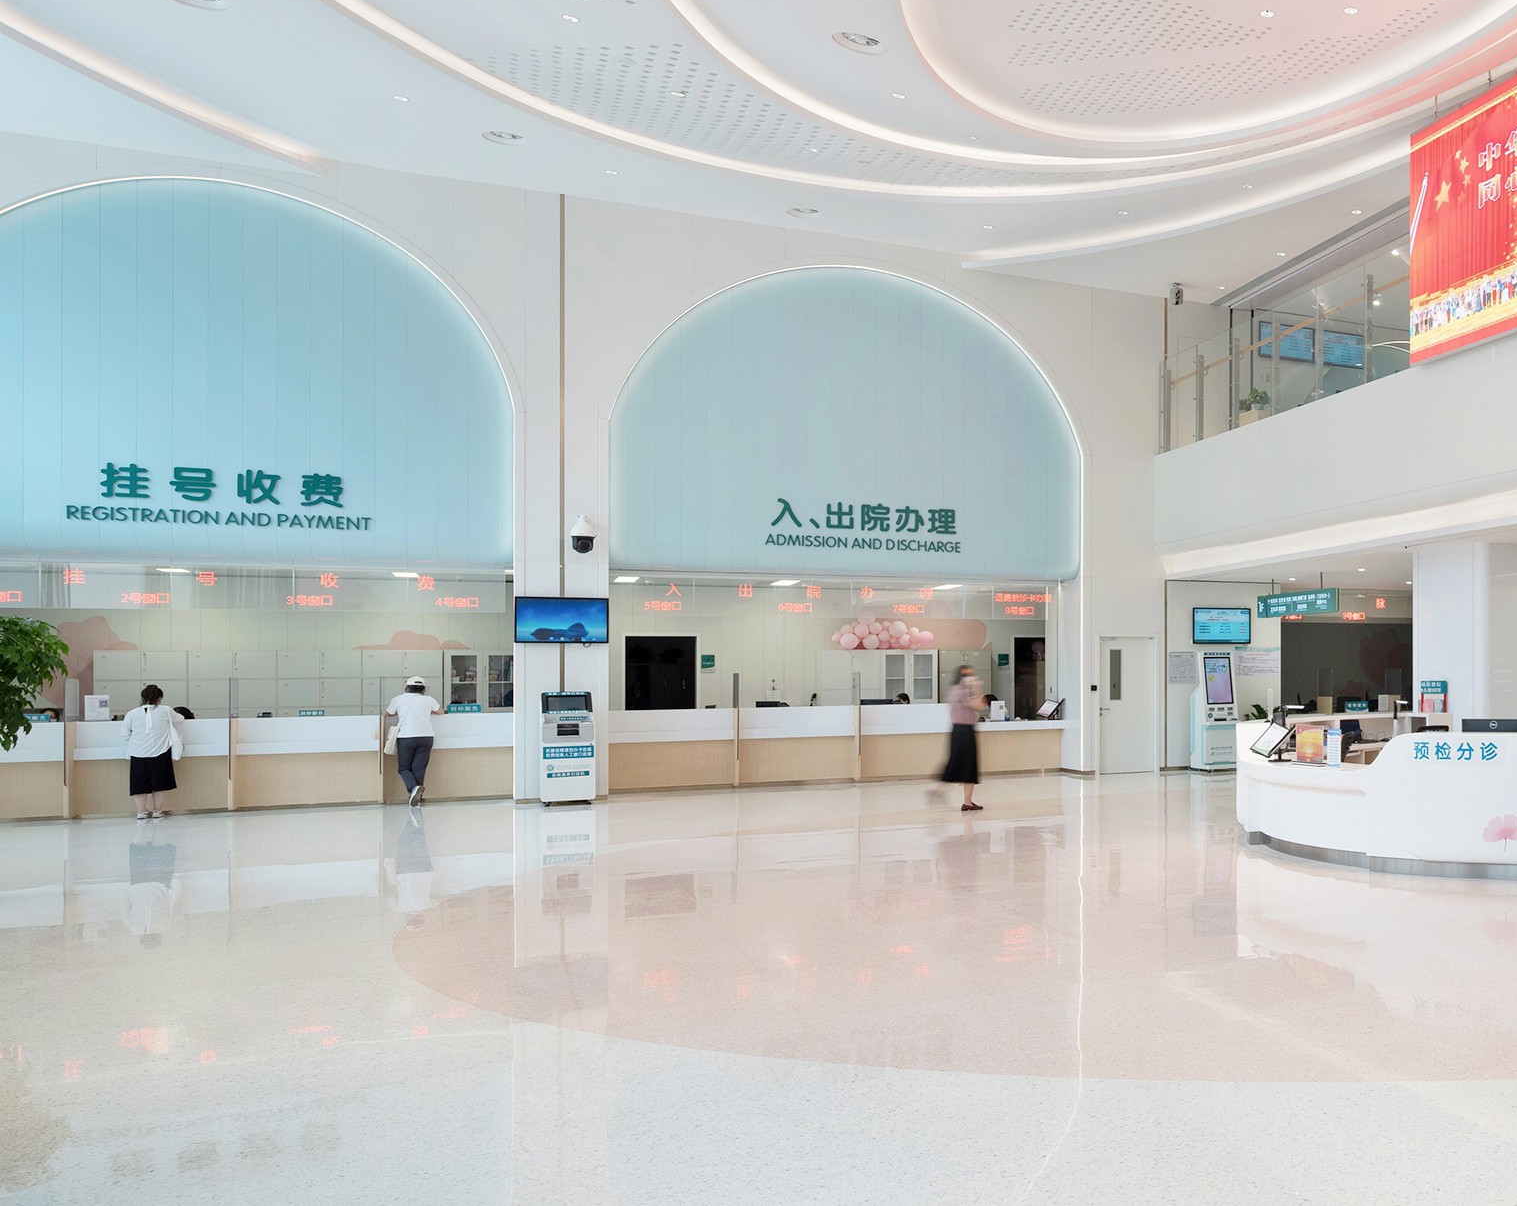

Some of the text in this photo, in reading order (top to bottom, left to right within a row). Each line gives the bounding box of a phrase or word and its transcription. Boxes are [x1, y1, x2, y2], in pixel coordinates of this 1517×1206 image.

[100, 462, 345, 508] 挂号收费
[66, 505, 371, 531] REGISTRATION AND PAYMENT
[771, 498, 957, 535] 入、出院办理
[765, 533, 961, 553] ADMISSION AND DISCHARGE
[121, 593, 170, 604] 2号窗口
[286, 595, 333, 606] 3号窗口
[435, 597, 479, 608] 4号窗口
[645, 601, 682, 611] 5号窗口
[777, 602, 813, 613] 6号窗口
[892, 603, 925, 614] 7号窗口
[1005, 606, 1034, 615] 8号窗口
[1414, 742, 1498, 761] 预检分诊
